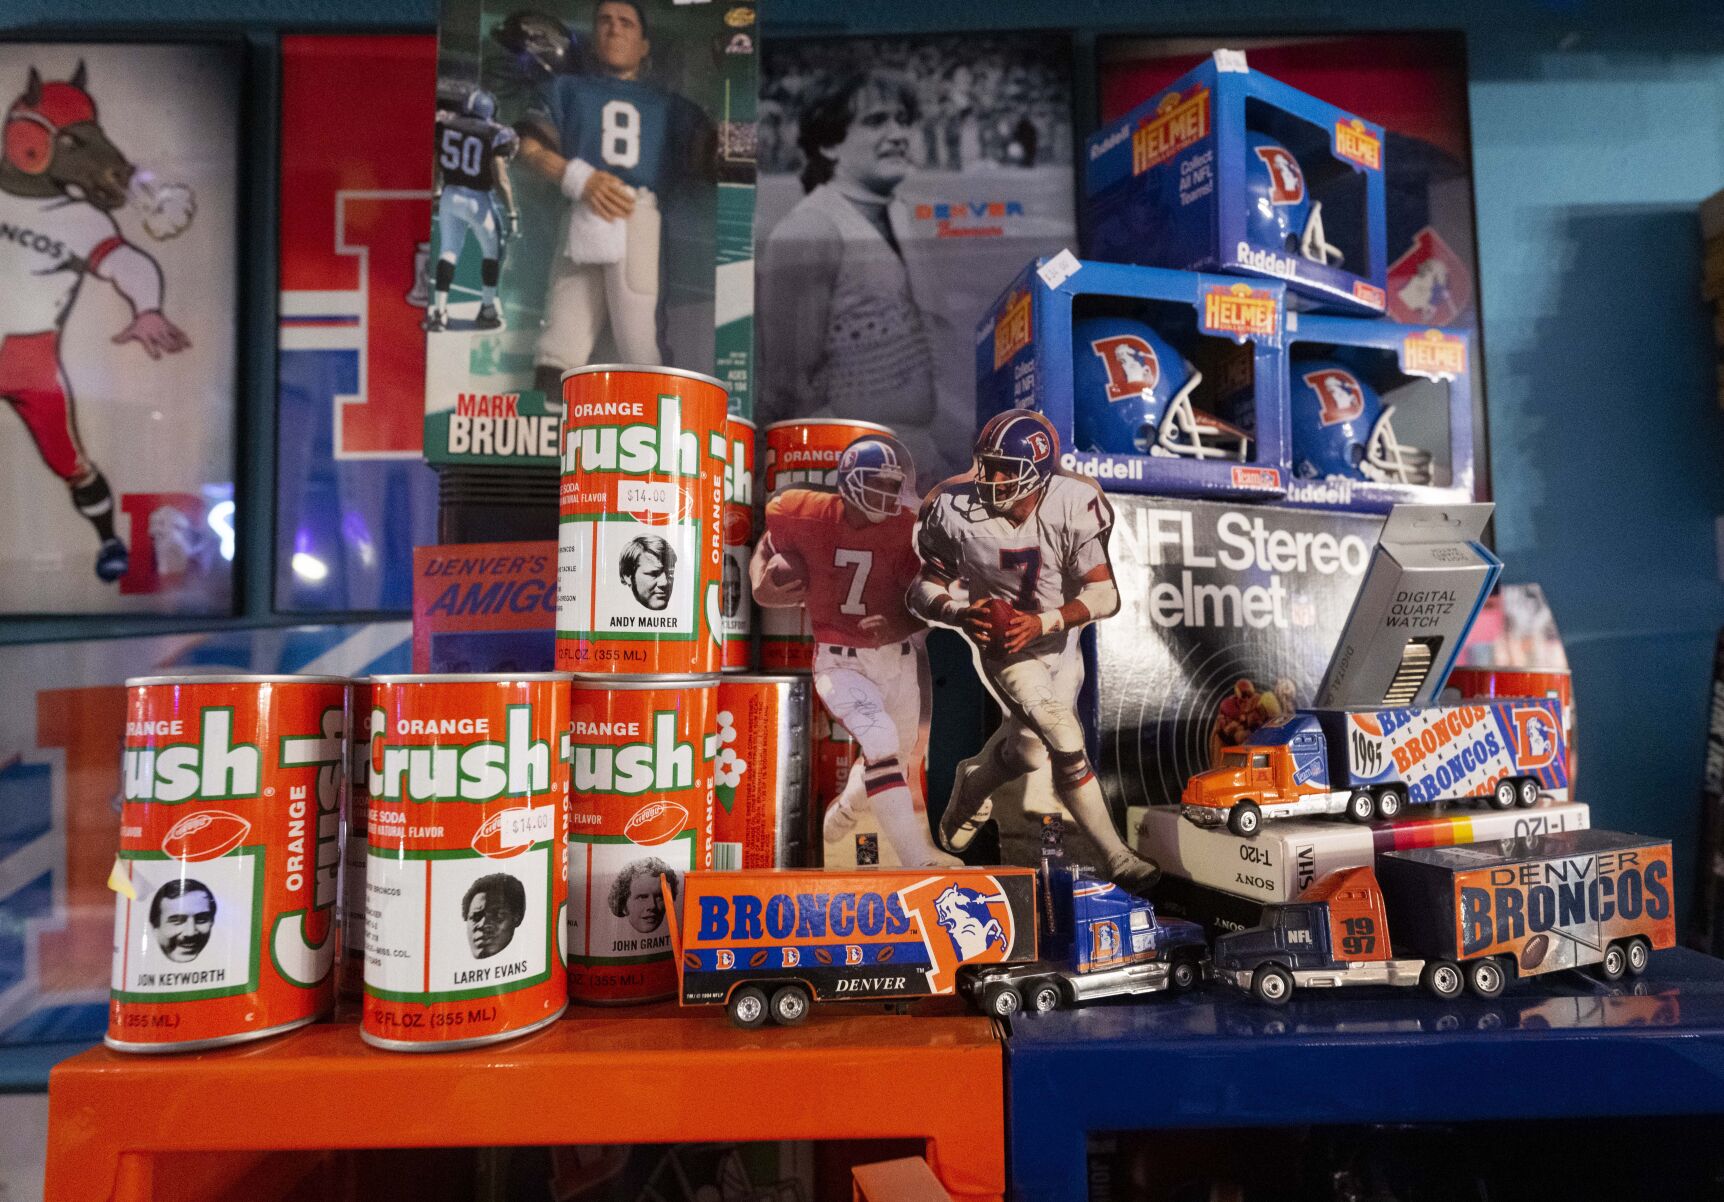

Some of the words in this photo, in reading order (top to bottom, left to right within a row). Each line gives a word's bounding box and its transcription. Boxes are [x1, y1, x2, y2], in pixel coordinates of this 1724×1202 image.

[602, 100, 640, 168] 8
[440, 130, 483, 177] 50
[1237, 242, 1296, 278] Riddell
[456, 394, 519, 418] MARK
[574, 402, 643, 417] ORANGE
[783, 451, 842, 462] ORANGE
[581, 493, 607, 503] FLAVOR
[627, 488, 666, 502] $14.00
[711, 475, 721, 564] ORANGE
[1113, 506, 1216, 567] NFL
[1217, 511, 1368, 575] Stereo
[424, 555, 548, 577] DENVER'S
[834, 549, 873, 616] 7
[999, 547, 1042, 612] 7
[1151, 570, 1288, 629] elmet
[1396, 590, 1457, 603] DIGITAL
[1391, 603, 1454, 616] QUARTZ
[609, 616, 635, 629] ANDY
[638, 616, 678, 629] MAURER
[1385, 616, 1439, 628] WATCH
[127, 720, 183, 737] RANGE
[397, 719, 489, 735] ORANGE
[570, 721, 640, 736] ORANGE
[124, 710, 259, 802] ush
[570, 713, 693, 794] ush
[1352, 728, 1382, 776] 1995
[1408, 730, 1501, 804] BRONCOS
[379, 811, 406, 824] SODA
[512, 813, 548, 834] $14.00
[575, 813, 602, 825] FLAVOR
[705, 776, 713, 867] ORANGE
[286, 785, 307, 891] ORANGE
[409, 826, 444, 838] FLAVOR
[1240, 844, 1273, 867] T-120
[1297, 846, 1315, 891] VHS
[1491, 851, 1640, 886] DENVER
[1235, 872, 1275, 891] SONY
[697, 892, 911, 942] BRONCOS
[1461, 860, 1669, 956] BRONCOS
[1287, 930, 1312, 944] NFL
[1340, 917, 1375, 935] 19
[612, 940, 637, 952] JOHN
[640, 935, 671, 950] GRANT
[1342, 936, 1376, 955] 97
[137, 973, 155, 987] JON
[158, 969, 225, 987] KEYWORTH
[454, 968, 491, 985] LARRY
[495, 960, 528, 979] EVANS
[835, 977, 906, 992] DENVER
[430, 1011, 462, 1028] (355
[468, 1006, 496, 1024] ML)
